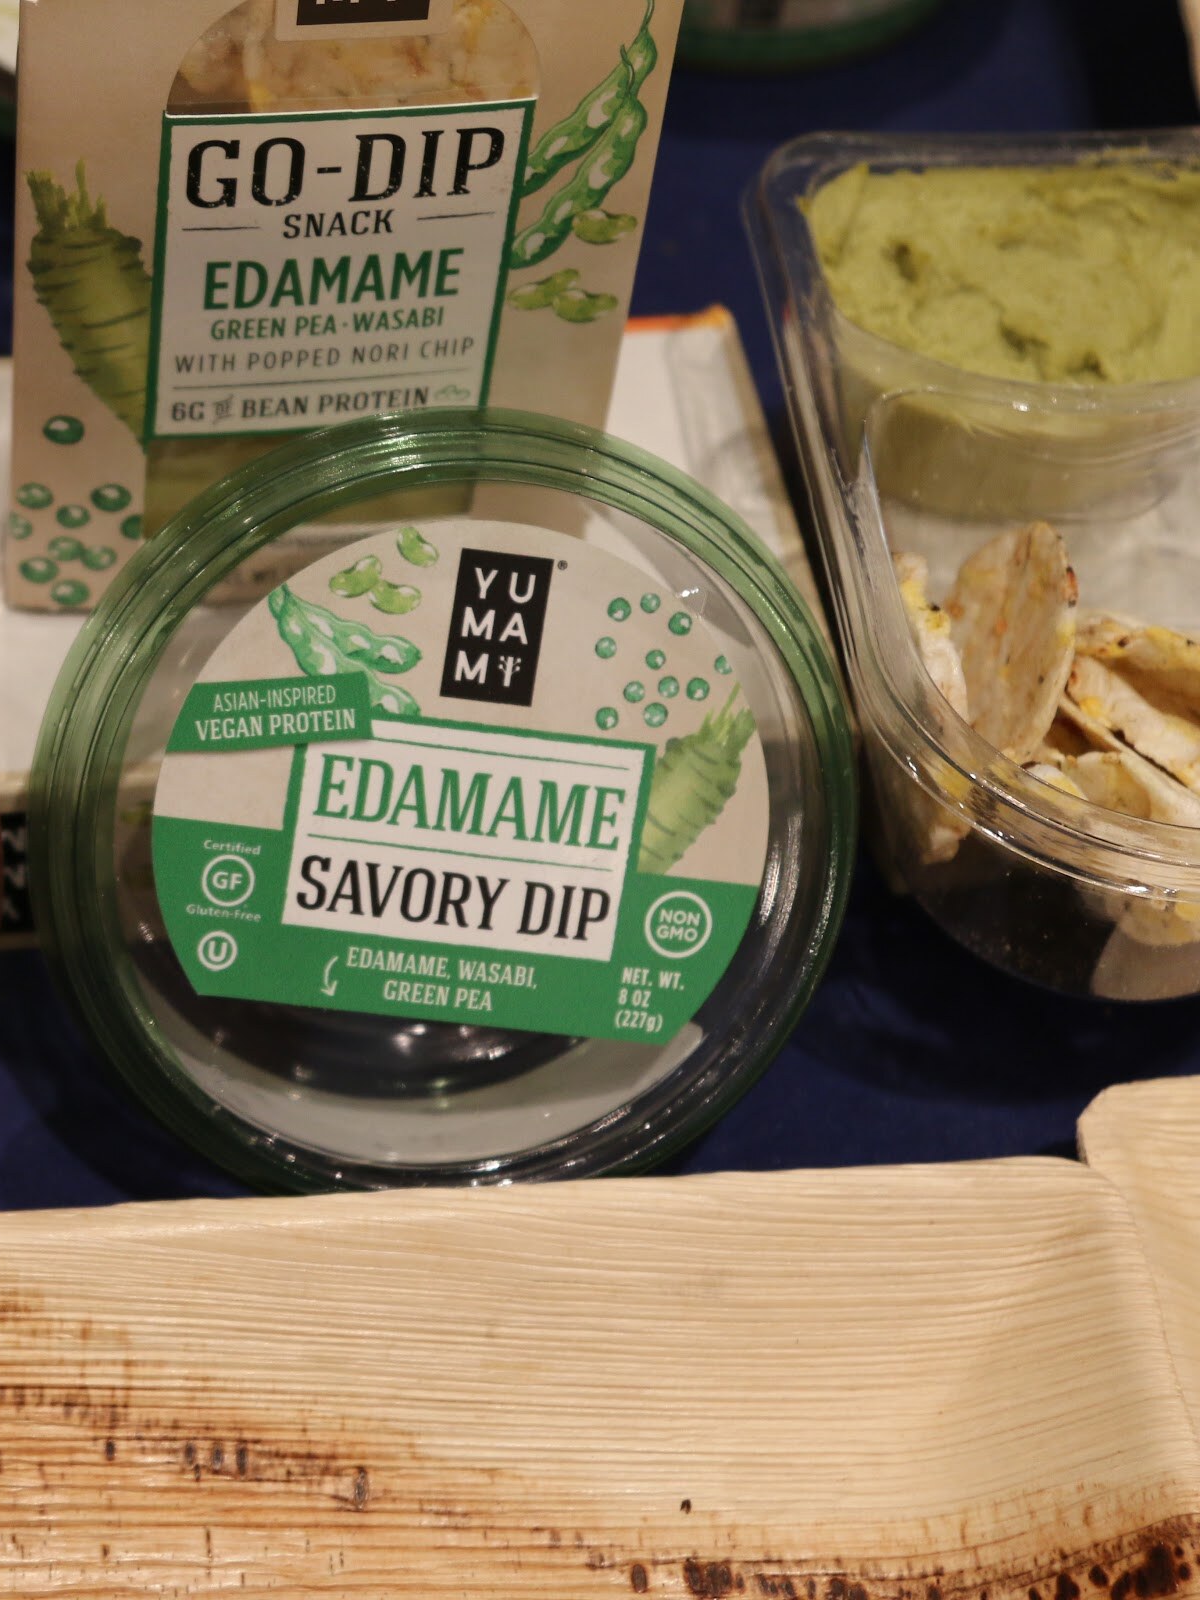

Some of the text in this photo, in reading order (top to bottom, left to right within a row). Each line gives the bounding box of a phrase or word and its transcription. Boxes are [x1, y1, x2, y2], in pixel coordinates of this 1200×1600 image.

[186, 127, 505, 208] GO-DIP
[283, 208, 394, 239] SNACK
[203, 248, 464, 311] EDAMAME
[211, 317, 286, 340] GREEN
[176, 337, 475, 374] WITH POPPED NORI CHIP
[172, 401, 204, 421] 6G
[241, 397, 308, 418] BEAN
[318, 386, 430, 414] PROTEIN
[213, 684, 336, 713] ASIAN-INSPIRED
[195, 708, 356, 741] VEGAN PROTEIN
[312, 752, 626, 852] EDAMAME
[203, 839, 261, 855] Certified
[212, 871, 243, 891] GF
[186, 903, 261, 922] Gluten-Free
[296, 854, 611, 941] SAVORY DIP
[660, 908, 700, 926] NON
[656, 924, 698, 942] GMO
[346, 946, 537, 990] EDAMAME, WASABI,
[622, 967, 685, 991] NET. WT.
[383, 979, 493, 1011] GREEN PEA
[618, 988, 651, 1007] 8 OZ
[615, 1010, 663, 1032] (227g)
